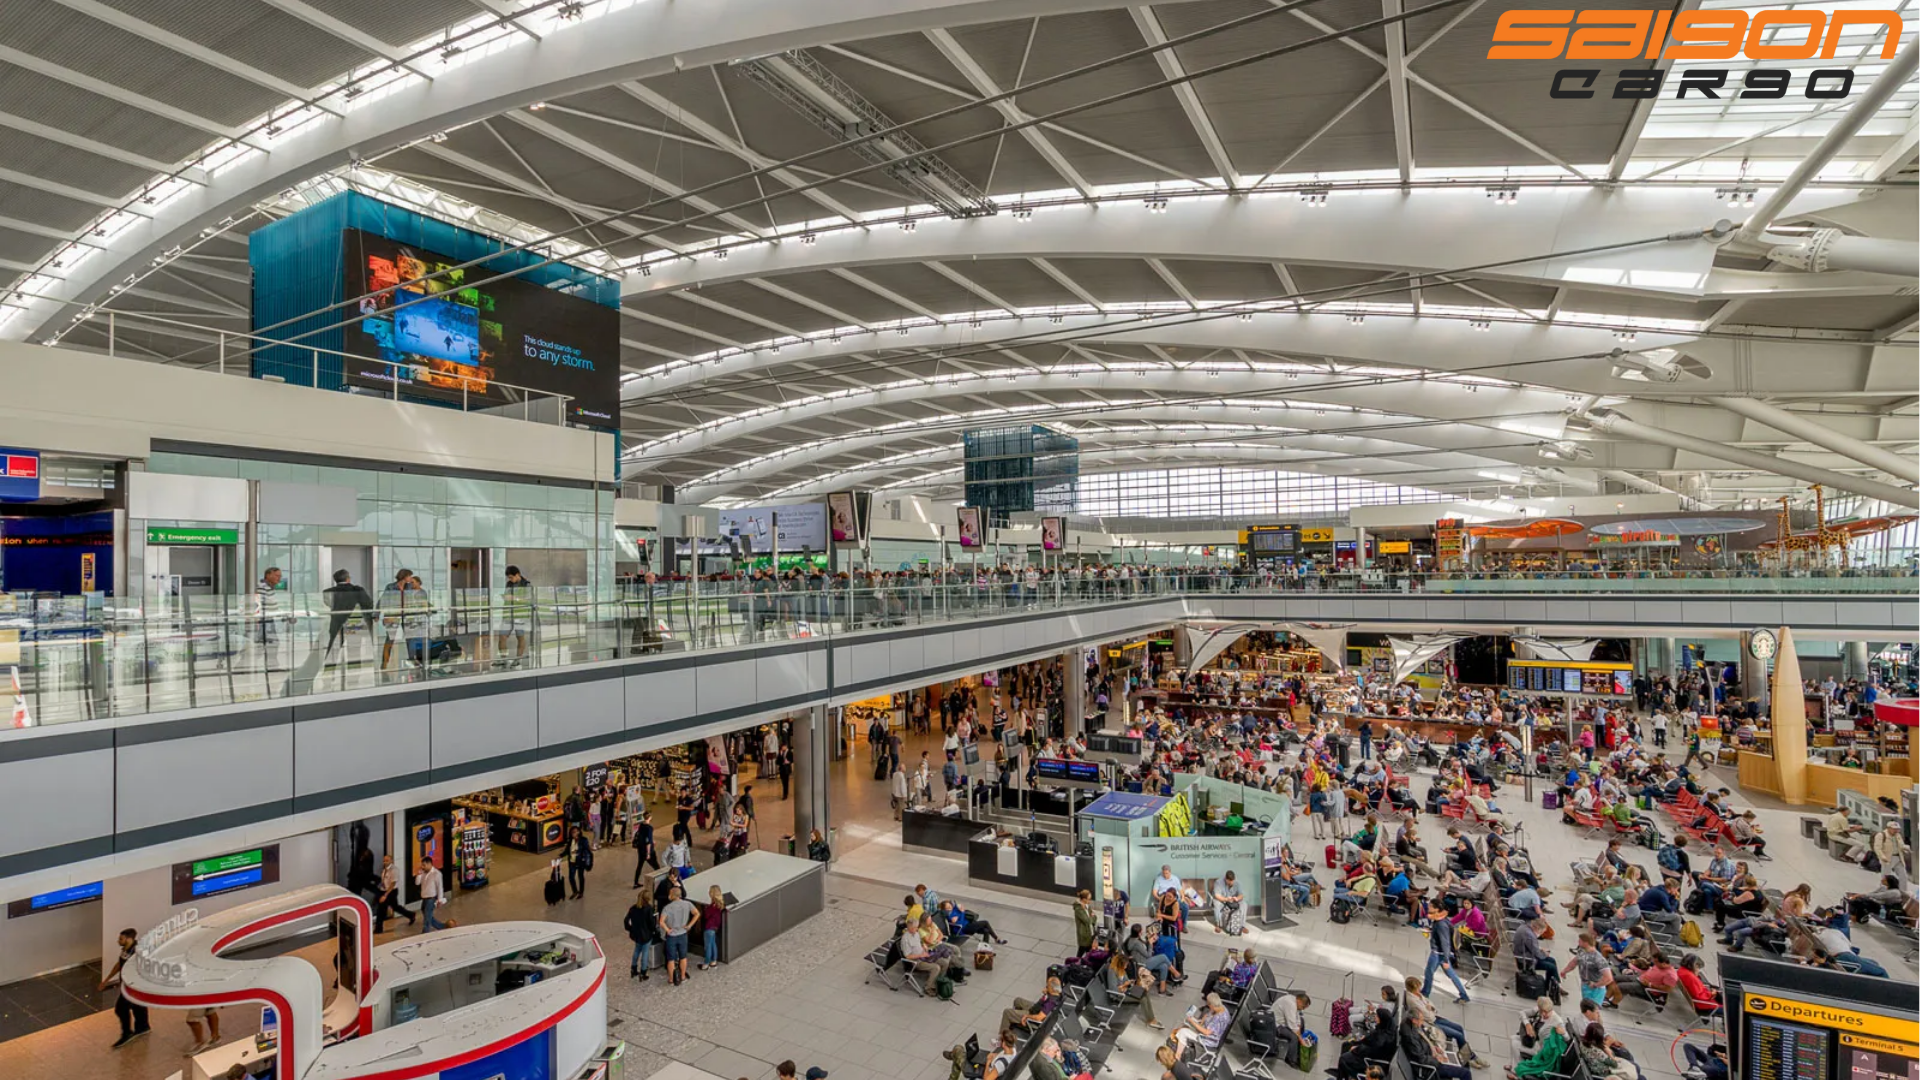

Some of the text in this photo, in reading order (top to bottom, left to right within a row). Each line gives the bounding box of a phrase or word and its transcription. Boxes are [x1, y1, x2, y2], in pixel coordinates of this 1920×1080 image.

[524, 335, 582, 356] This cloud stands up
[524, 344, 596, 371] to any storm.
[26, 537, 49, 545] when
[168, 534, 207, 542] Emergency
[592, 768, 607, 778] FOR
[586, 777, 600, 786] £20
[1170, 852, 1200, 860] Customer
[1233, 851, 1256, 859] Central
[1770, 1000, 1864, 1027] Departures
[1855, 1037, 1896, 1051] Terminal
